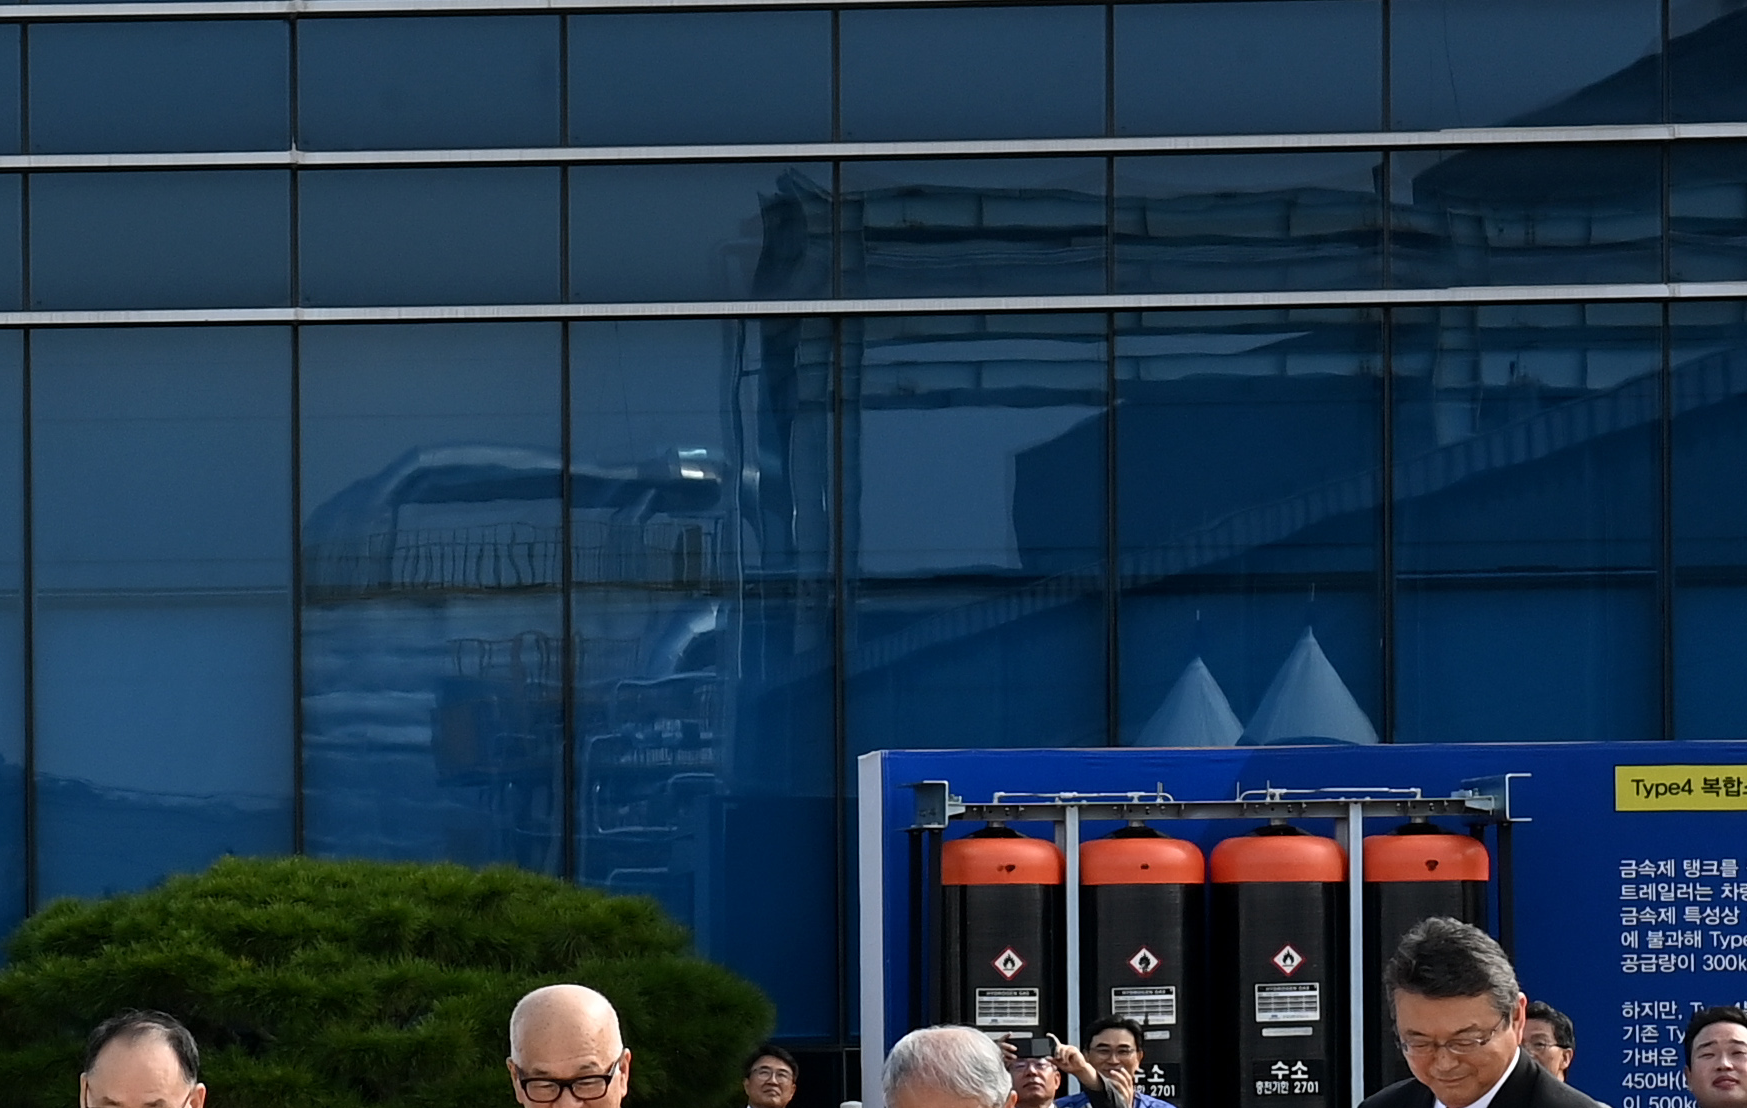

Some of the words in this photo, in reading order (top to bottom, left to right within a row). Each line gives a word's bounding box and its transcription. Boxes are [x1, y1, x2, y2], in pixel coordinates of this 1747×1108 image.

[1631, 779, 1694, 799] Type4
[1701, 776, 1747, 797] 복합
[1619, 860, 1675, 878] 금속제
[1683, 859, 1739, 878] 탱크를
[1620, 883, 1713, 901] 트레일러는
[1620, 907, 1676, 925] 금속제
[1683, 906, 1740, 925] 특성상
[1621, 931, 1638, 948] 에
[1646, 930, 1702, 949] 불과해
[1621, 954, 1695, 973] 공급량이
[1622, 1001, 1683, 1020] 하지만,
[1623, 1025, 1659, 1043] 기존
[1666, 1026, 1686, 1044] Ty
[1623, 1048, 1678, 1067] 가벼운
[1271, 1061, 1309, 1080] 수소
[1150, 1085, 1176, 1097] 2701
[1294, 1081, 1319, 1094] 2701
